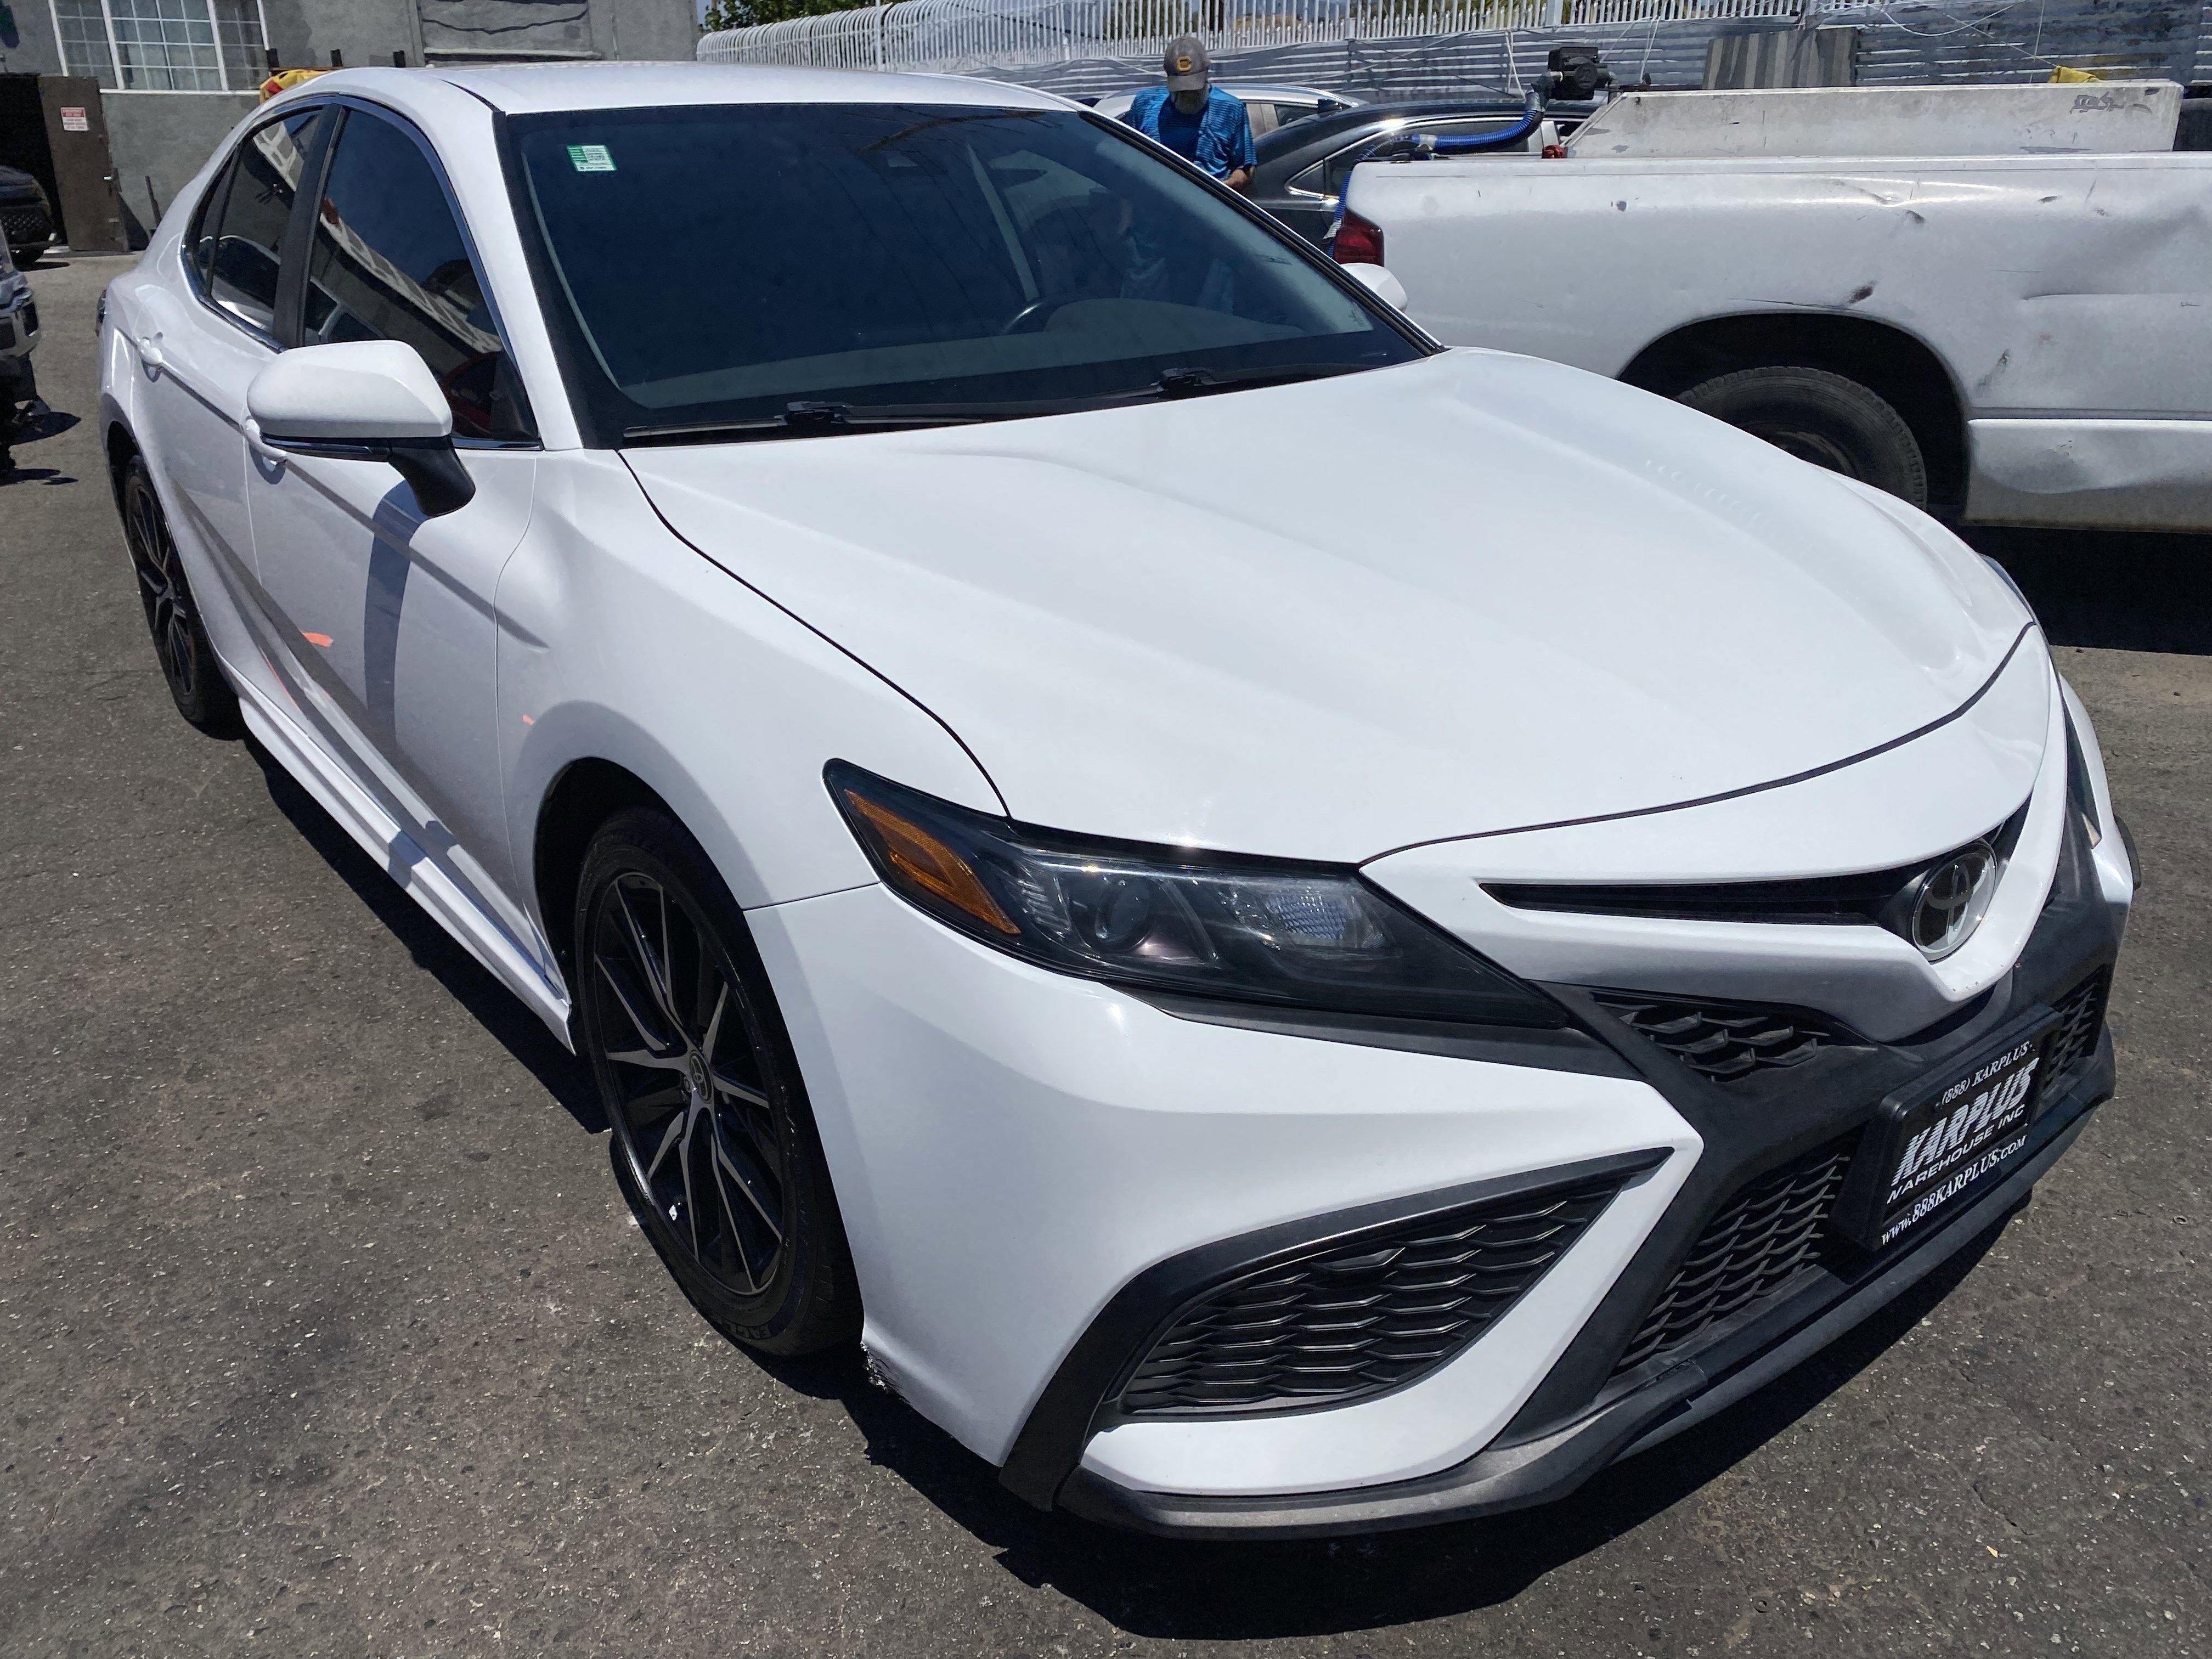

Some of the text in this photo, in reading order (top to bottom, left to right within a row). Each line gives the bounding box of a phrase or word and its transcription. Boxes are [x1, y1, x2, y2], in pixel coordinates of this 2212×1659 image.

[1942, 1041, 2029, 1105] (888) KARPLUS
[1891, 1057, 2039, 1186] KARPLUS
[1998, 1104, 2025, 1129] INC
